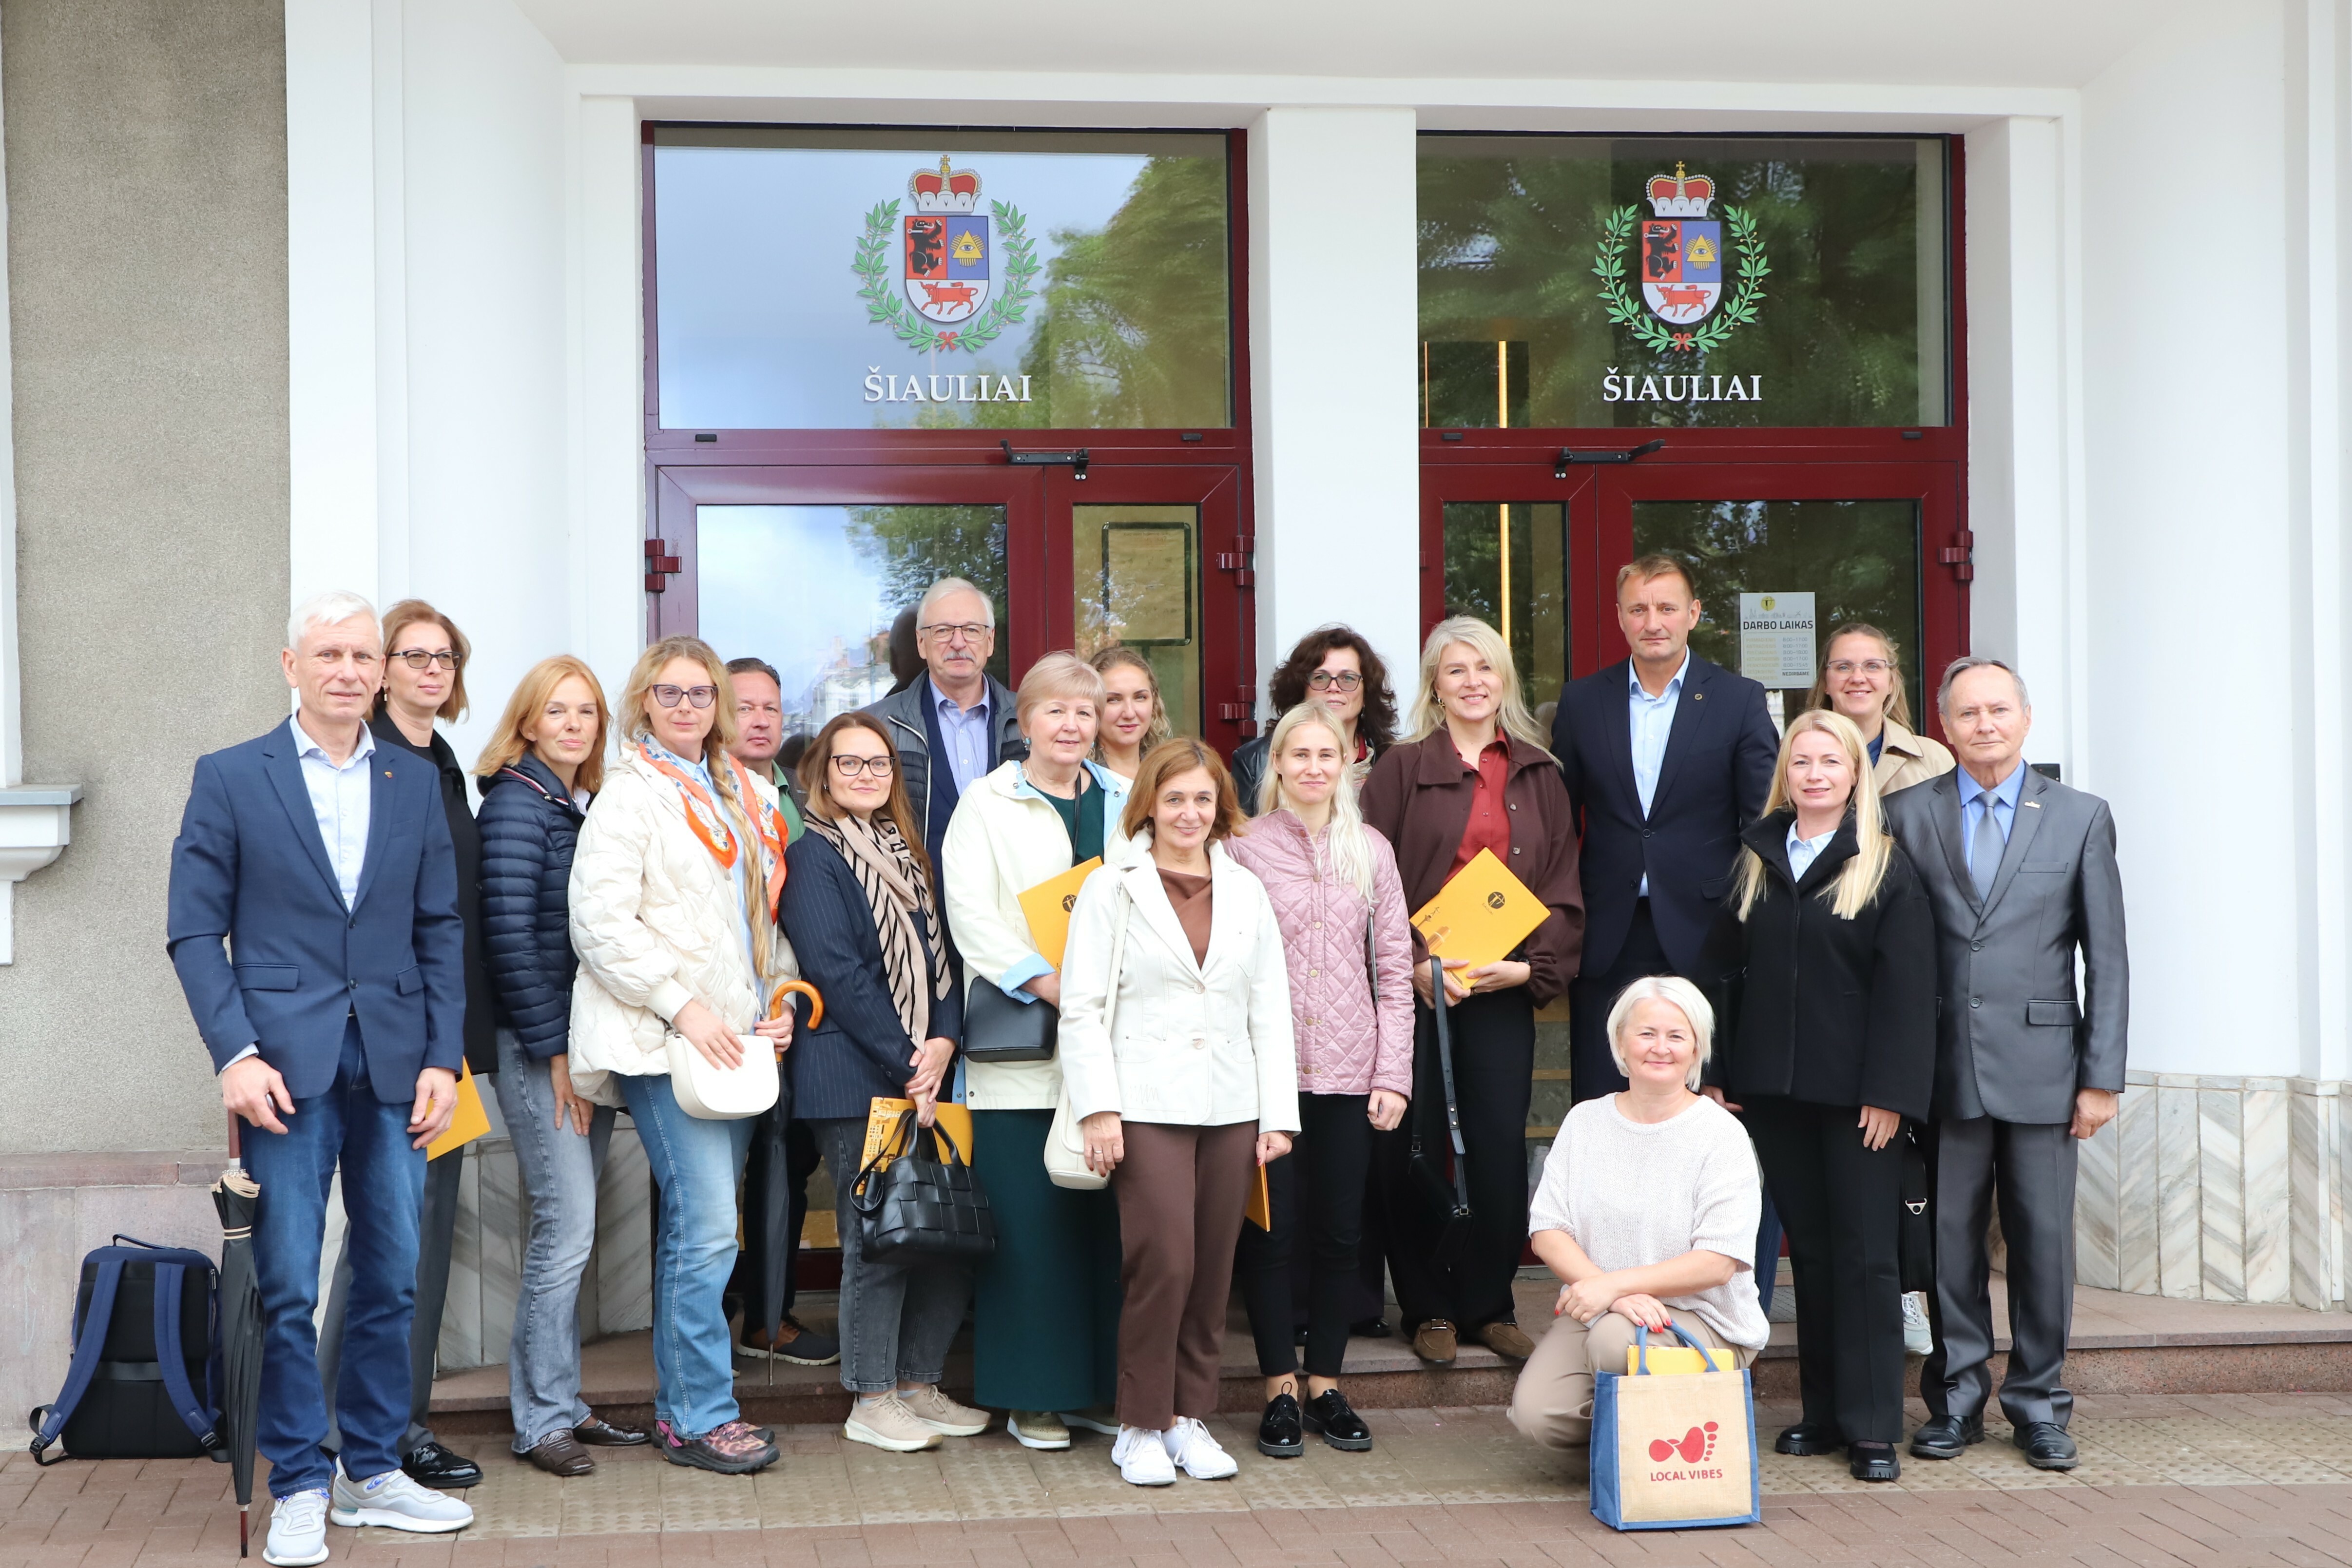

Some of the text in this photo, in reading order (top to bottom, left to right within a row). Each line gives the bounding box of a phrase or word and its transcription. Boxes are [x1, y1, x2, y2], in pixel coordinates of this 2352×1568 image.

[864, 366, 1032, 402] ŠIAULIAI
[1602, 367, 1763, 402] ŠIAULIAI
[1743, 620, 1813, 630] DARBO LAIKAS
[1650, 1469, 1723, 1481] LOCAL VIBES
